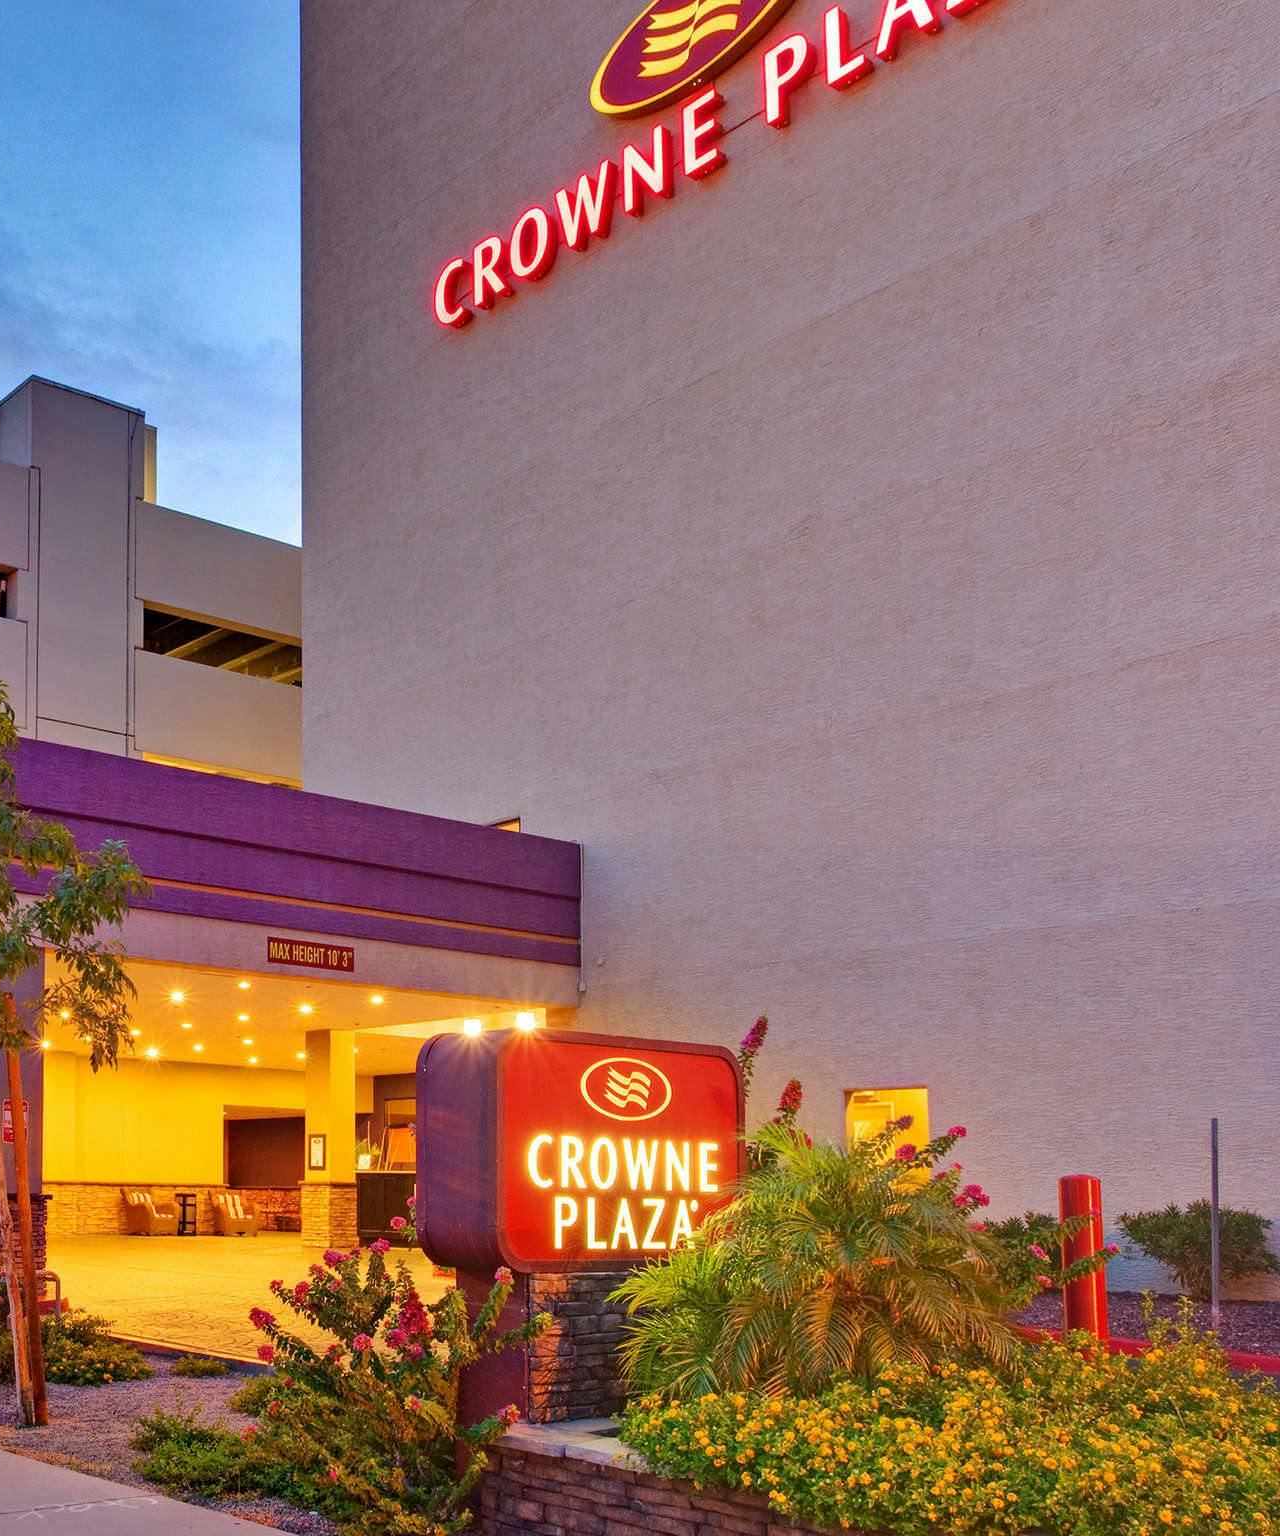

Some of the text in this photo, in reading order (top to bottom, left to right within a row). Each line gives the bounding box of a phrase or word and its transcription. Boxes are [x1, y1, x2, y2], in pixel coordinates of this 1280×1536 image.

[433, 0, 985, 328] CROWNE PLA
[269, 941, 290, 961] MAX
[292, 944, 326, 965] HEIGHT
[527, 1134, 720, 1193] CROWNE
[554, 1196, 697, 1250] PLAZA
